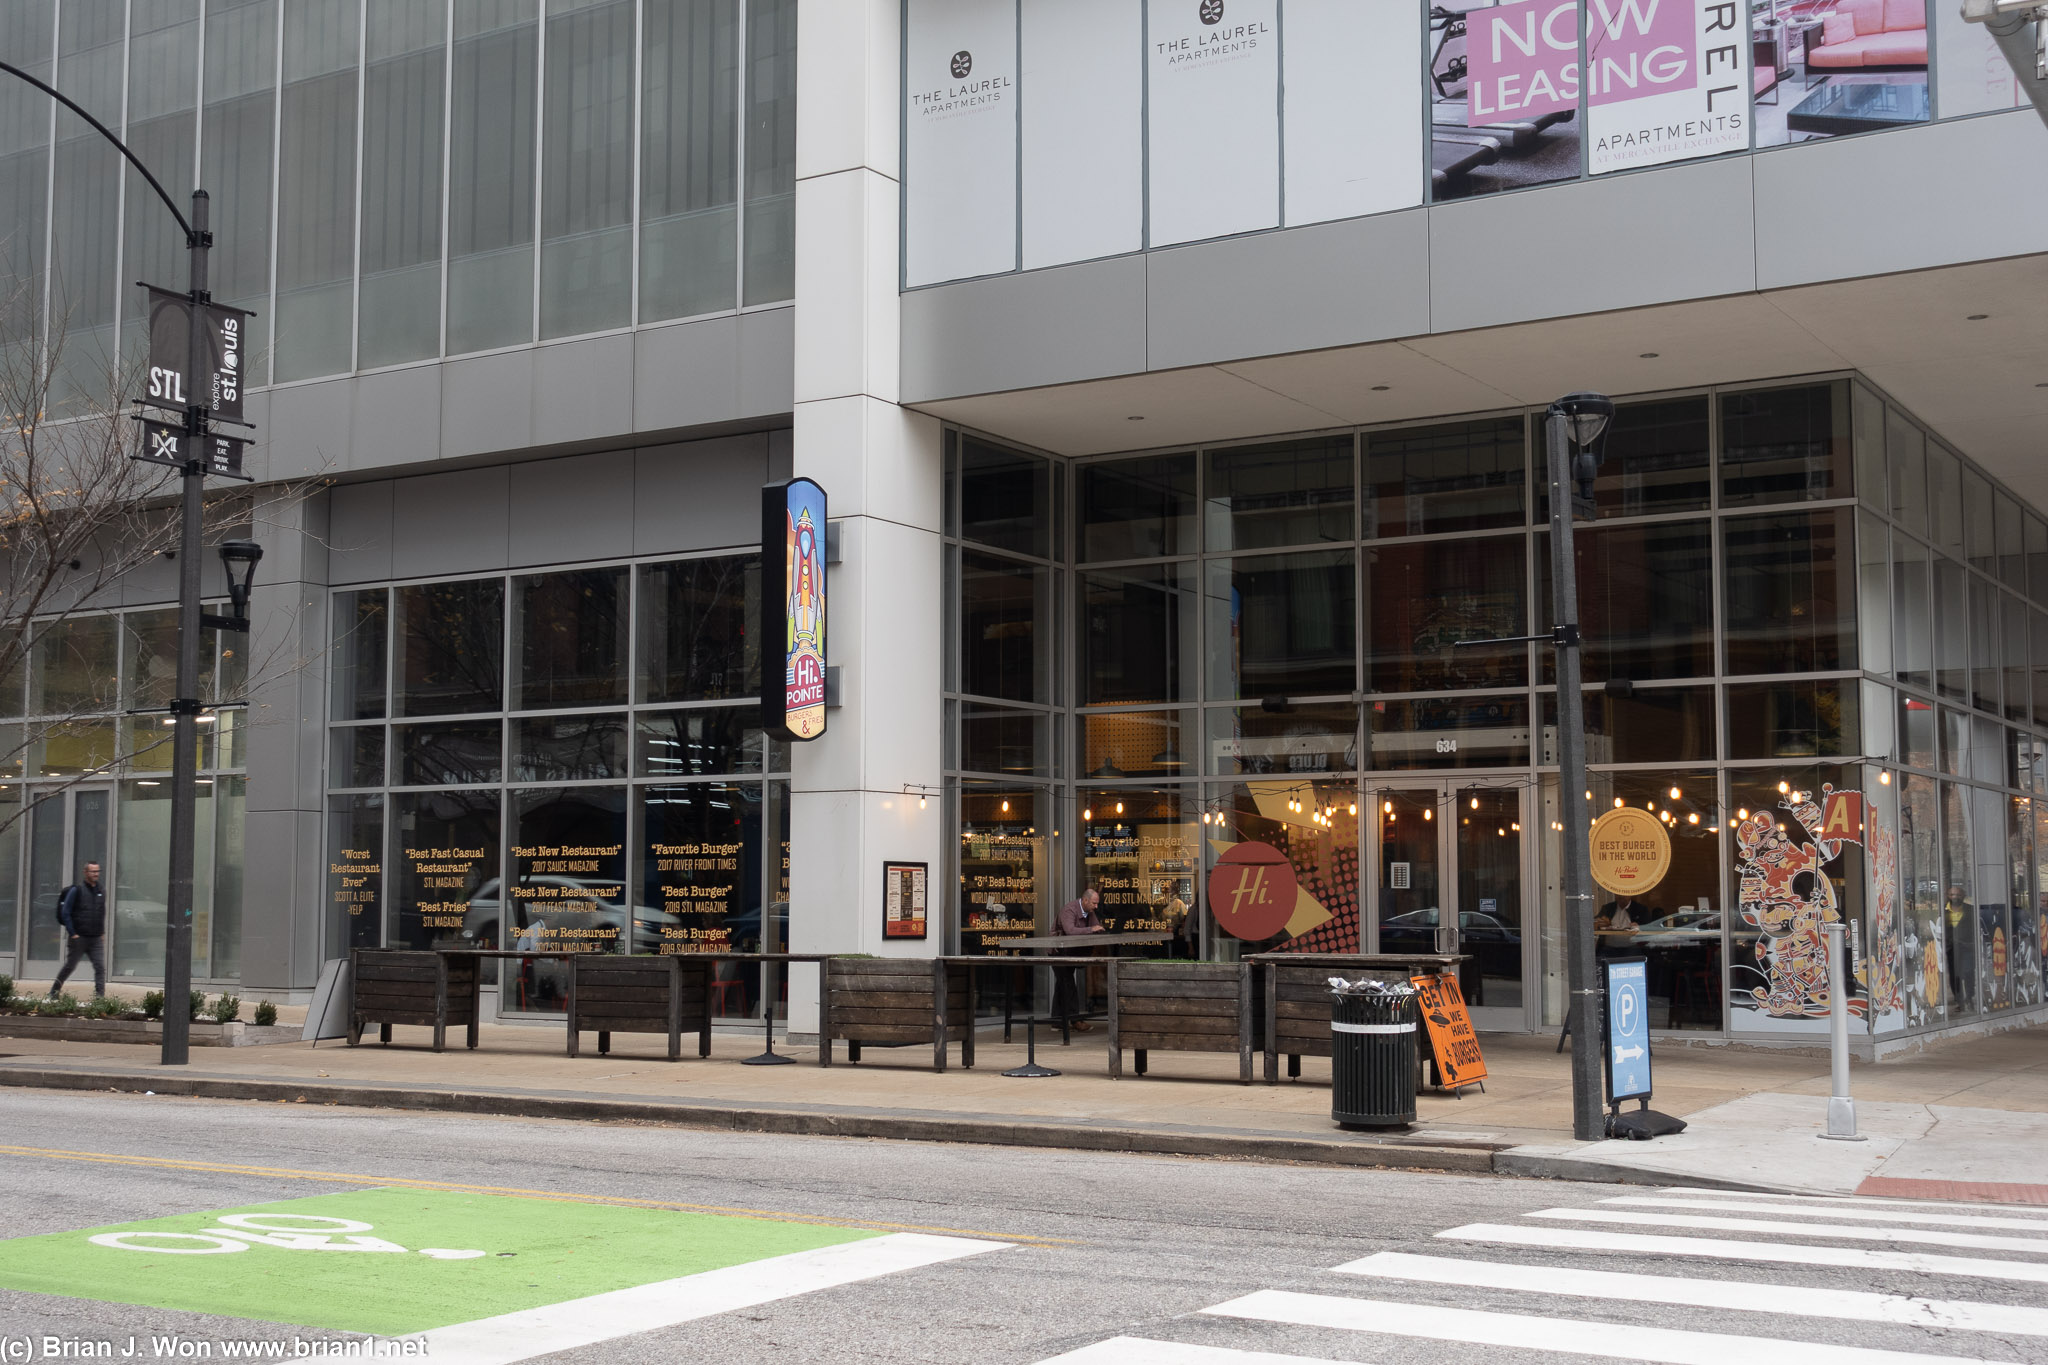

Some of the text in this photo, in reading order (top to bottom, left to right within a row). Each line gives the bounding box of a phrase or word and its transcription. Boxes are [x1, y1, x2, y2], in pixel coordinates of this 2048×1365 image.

[1157, 22, 1268, 54] THE LAUREL
[1491, 0, 1660, 64] NOW
[1168, 39, 1257, 65] APARTMENTS
[1474, 45, 1688, 116] LEASING
[913, 76, 1011, 105] THE LAUREL
[922, 92, 1001, 116] APARTMENTS
[1596, 113, 1742, 152] APARTMENTS
[1613, 142, 1682, 161] MERCANTILE
[1683, 132, 1743, 149] EXCHANGE
[150, 366, 187, 403] STL
[212, 372, 221, 411] explore
[798, 659, 819, 687] Hi.
[787, 684, 823, 705] POINTE
[787, 710, 813, 723] BURGERS
[801, 719, 811, 735] &
[1436, 740, 1457, 753] 634
[1825, 796, 1849, 833] A
[511, 844, 622, 857] “Best New Restaurant”
[651, 842, 743, 856] “Favorite Burger”
[1599, 840, 1656, 850] BEST BURGER
[341, 849, 371, 859] “Worst
[405, 847, 485, 859] “Best Fast Casual
[1599, 851, 1657, 861] IN THE WORLD
[331, 863, 381, 873] Restaurant
[416, 861, 473, 873] Restaurant”
[532, 860, 600, 873] 2017 SAUCE MAGAZINE
[657, 858, 737, 871] 2017 RIVER FRONT TIMES
[342, 877, 368, 887] Ever”
[423, 876, 465, 888] STL MAGAZINE
[988, 876, 1006, 887] Best
[1099, 877, 1130, 888] “Best
[334, 891, 375, 902] SCOTT A. ELITE
[510, 886, 622, 897] “Best New Restaurant”
[661, 885, 733, 899] “Best Burger”
[1231, 866, 1273, 914] Hi.
[1103, 893, 1120, 905] 2019
[1121, 892, 1136, 905] STL
[416, 901, 471, 912] “Best Fries”
[547, 901, 566, 913] FEAST
[567, 901, 598, 913] MAGAZINE
[664, 902, 728, 913] 2019 STL MAGAZINE
[422, 916, 463, 928] STL MAGAZINE
[1010, 918, 1035, 929] Casual
[1136, 918, 1172, 930] Fries”
[509, 927, 621, 938] “Best New Restaurant”
[660, 927, 732, 941] “Best Burger”
[562, 942, 594, 952] MAGAZINE
[659, 943, 733, 954] 2019 SAUCE MAGAZINE
[1420, 982, 1461, 1009] GET IN
[1449, 1010, 1464, 1023] WE
[1451, 1023, 1470, 1037] HAVE
